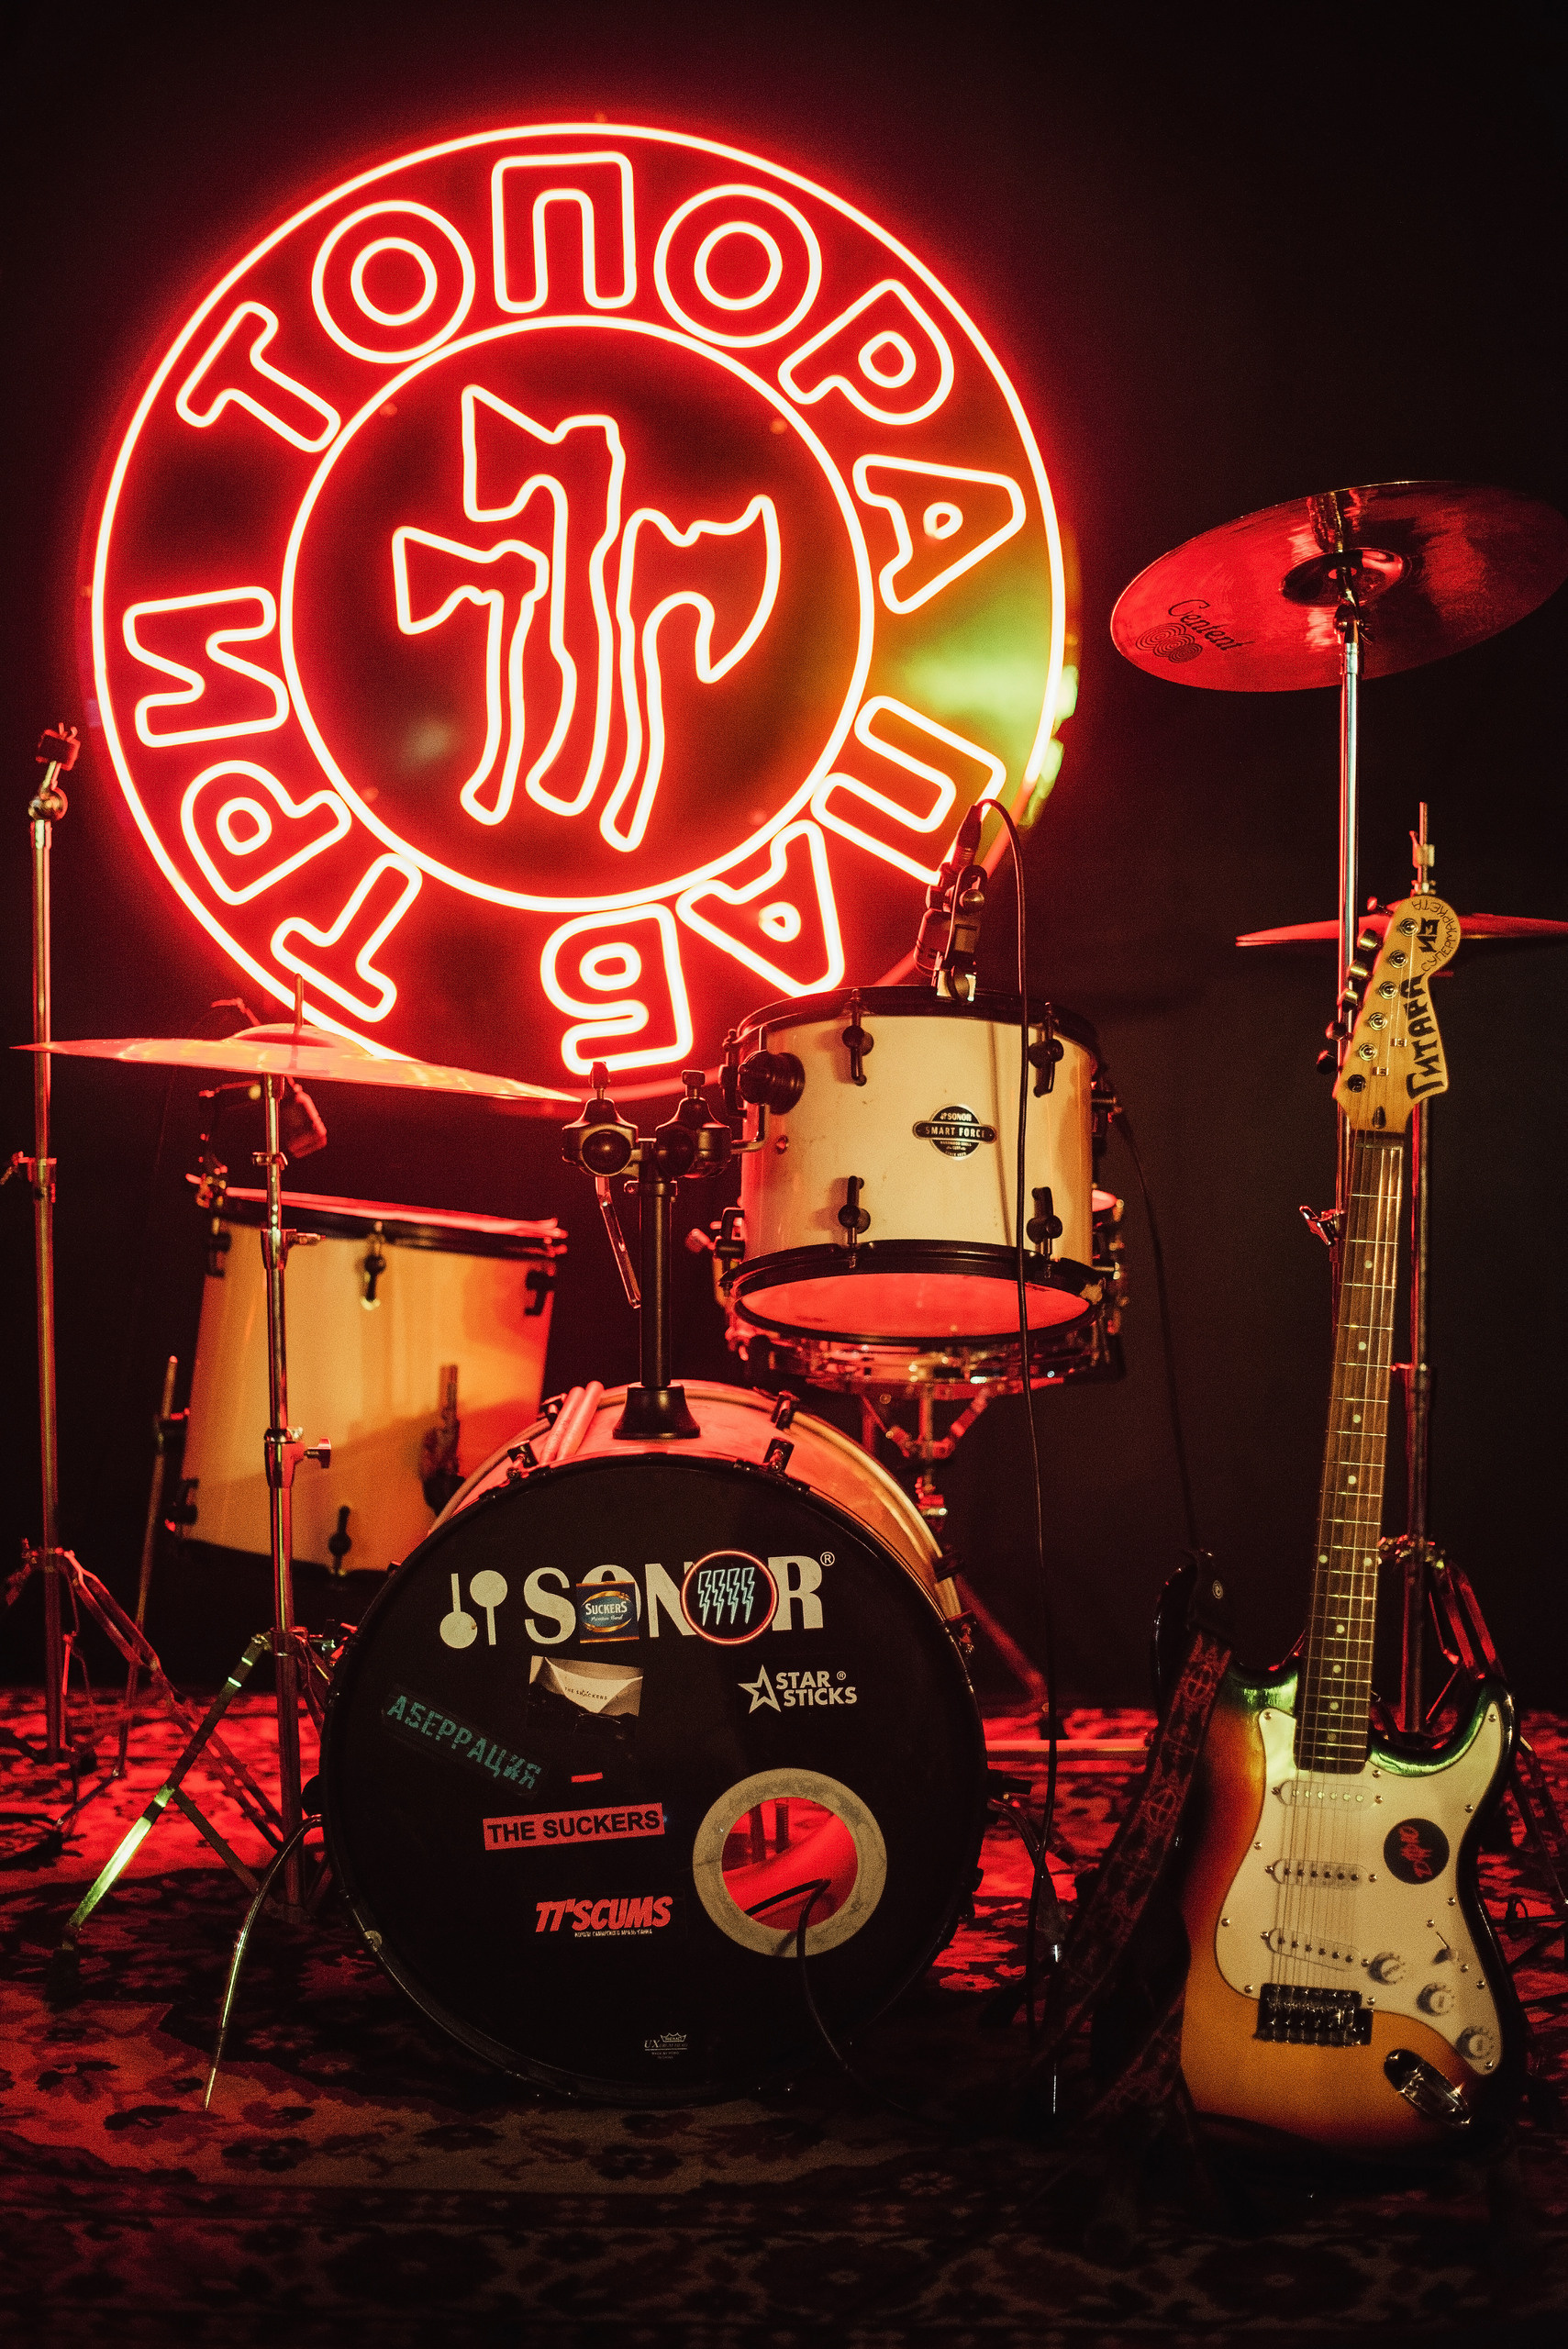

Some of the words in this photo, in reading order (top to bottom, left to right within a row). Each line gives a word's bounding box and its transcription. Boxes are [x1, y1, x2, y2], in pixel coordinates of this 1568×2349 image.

[177, 151, 1027, 613] ТОПОРА
[1168, 599, 1255, 651] Centent
[123, 586, 421, 1022] ТРИ
[540, 696, 1007, 1074] ПАБ
[1411, 900, 1459, 973] СУПЕРМАРКЕТА
[1418, 917, 1440, 953] ИЗ
[1400, 973, 1446, 1100] ГИТАРА
[926, 1126, 955, 1136] SMART
[948, 1112, 973, 1121] SONOR
[524, 1554, 824, 1644] SNR
[584, 1601, 628, 1615] SUCKERS
[775, 1670, 831, 1689] STAR
[784, 1687, 858, 1707] STICKS
[487, 1820, 537, 1843] THE
[542, 1809, 661, 1838] SUCKERS
